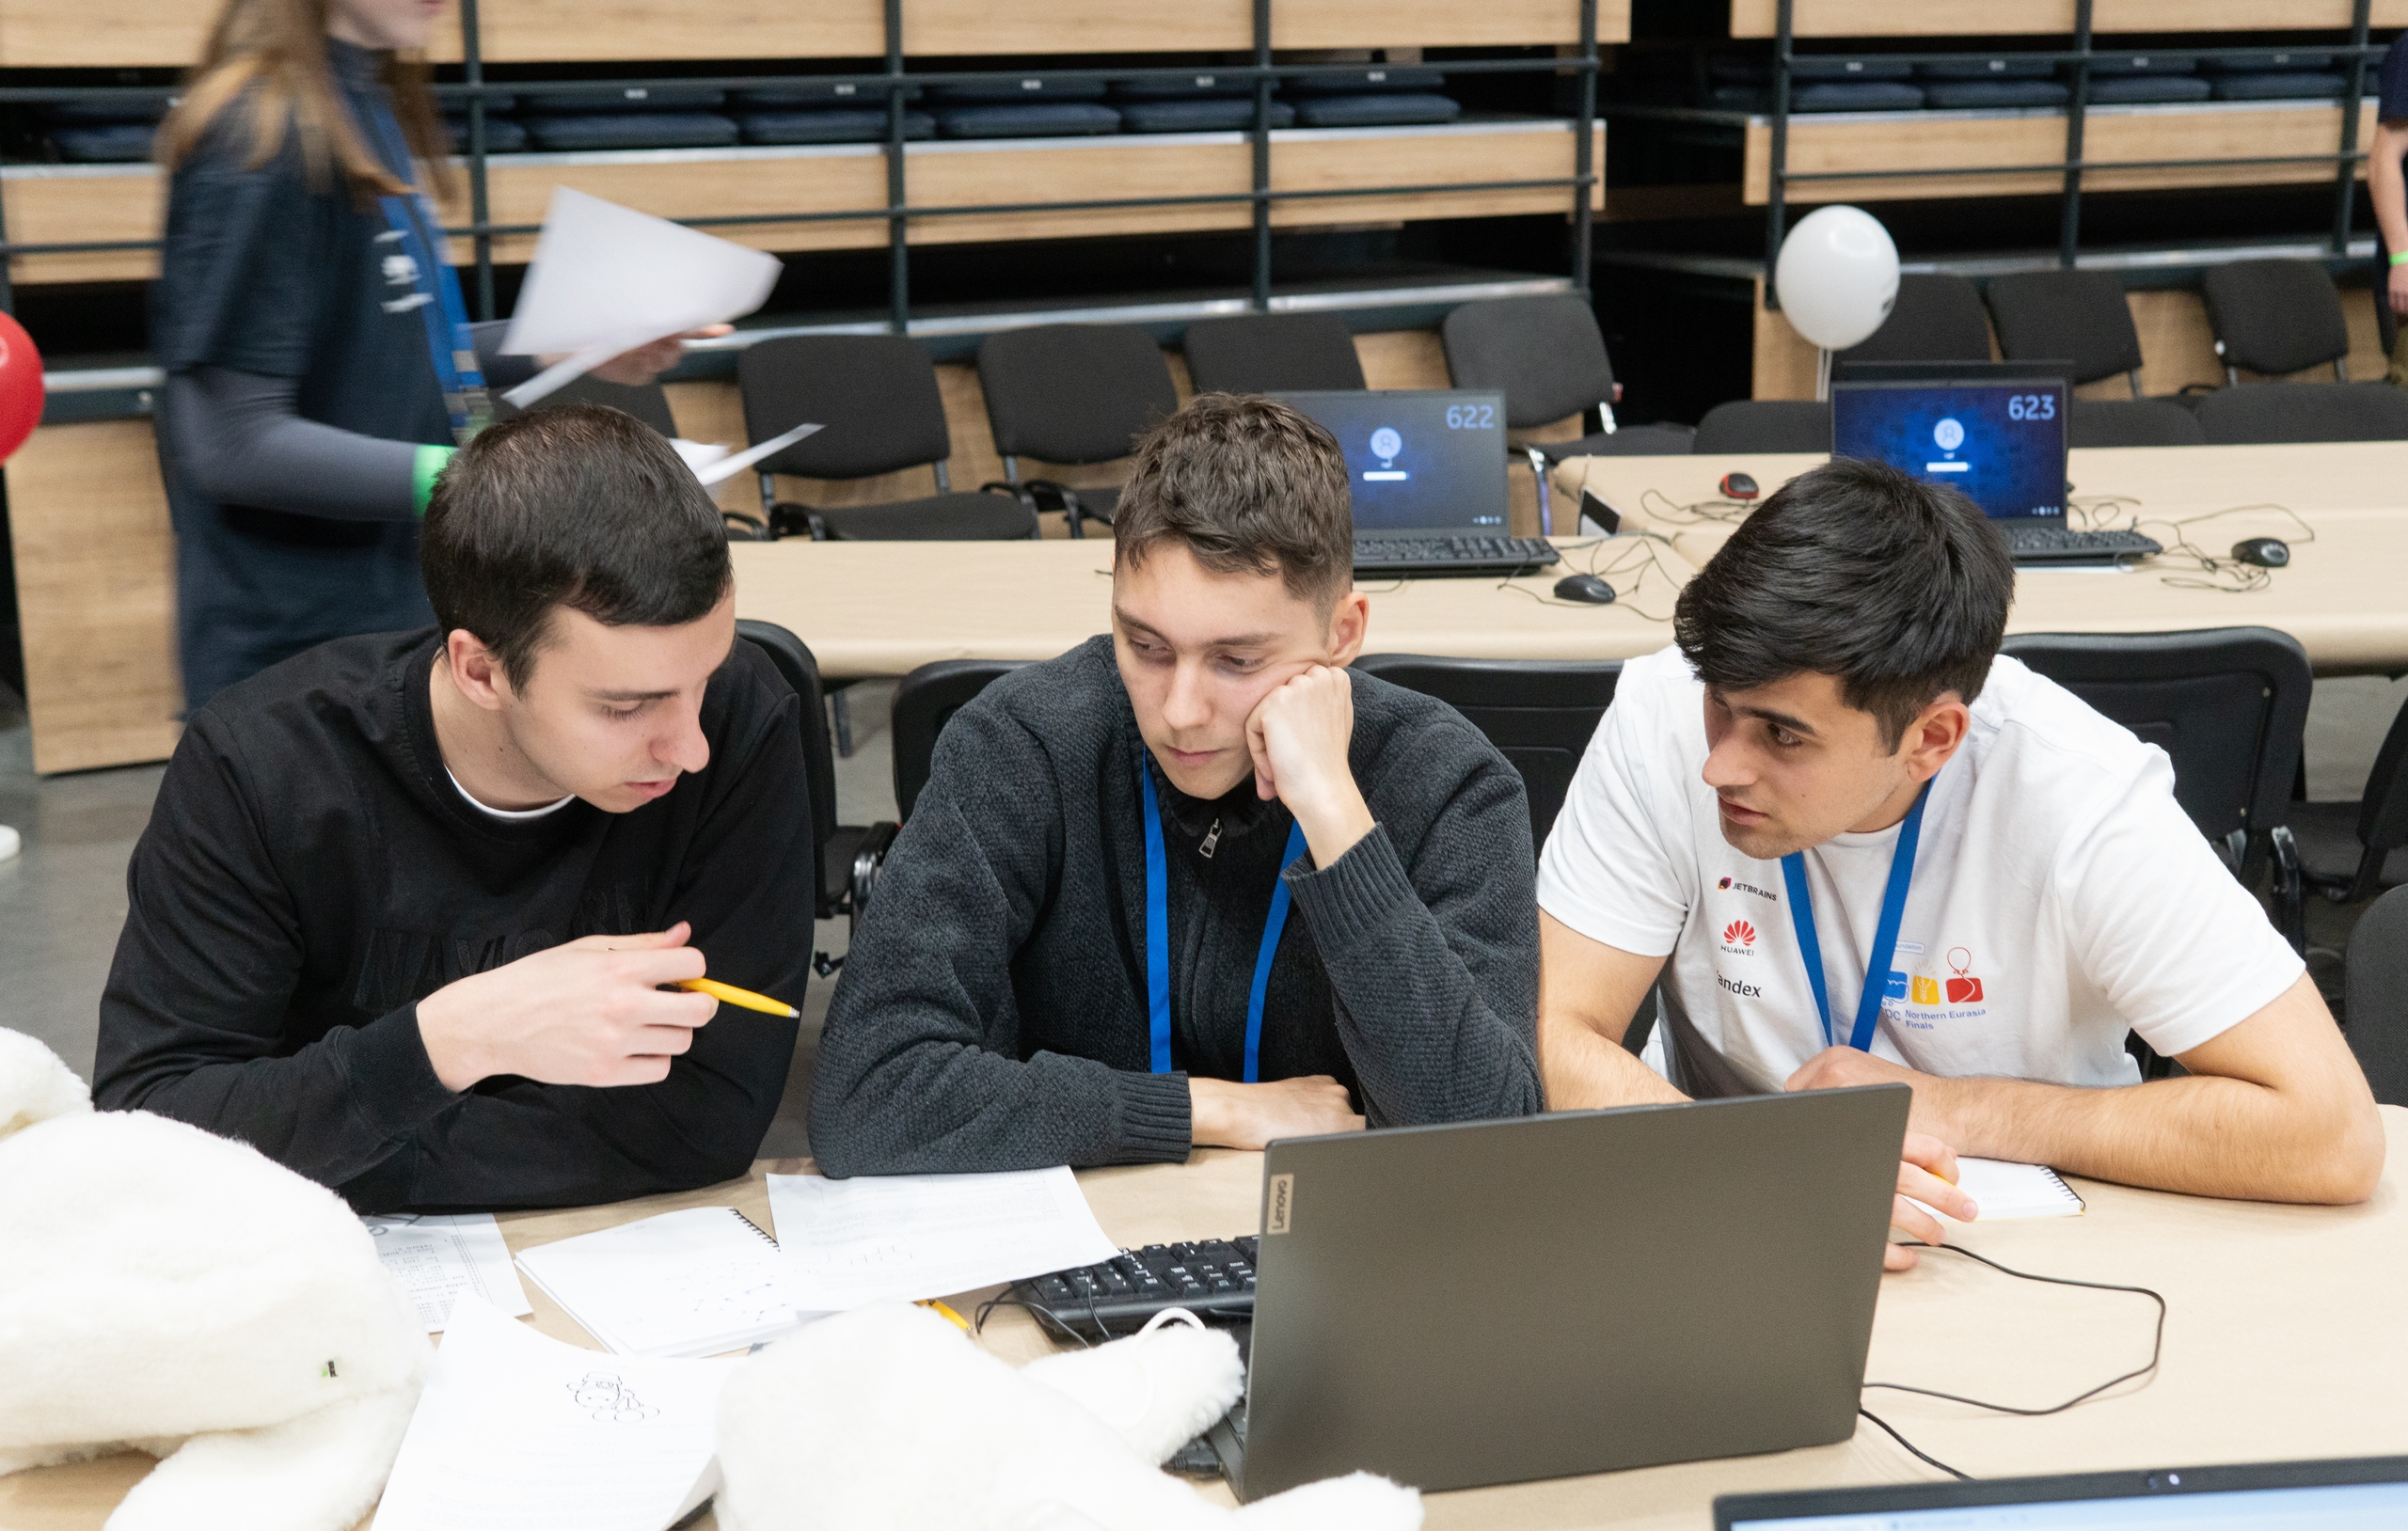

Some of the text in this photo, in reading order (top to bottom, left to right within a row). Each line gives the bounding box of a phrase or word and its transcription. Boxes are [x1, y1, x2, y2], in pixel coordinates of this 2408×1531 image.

[1446, 404, 1494, 429] 622
[2008, 394, 2055, 420] 623
[1733, 882, 1777, 901] JETBRAINS
[1720, 944, 1754, 956] HUAWEI
[1717, 970, 1761, 998] andex
[1905, 1008, 1987, 1020] Northern Eurasia
[1906, 1020, 1934, 1030] Finals
[1272, 1179, 1288, 1229] Lenovo
